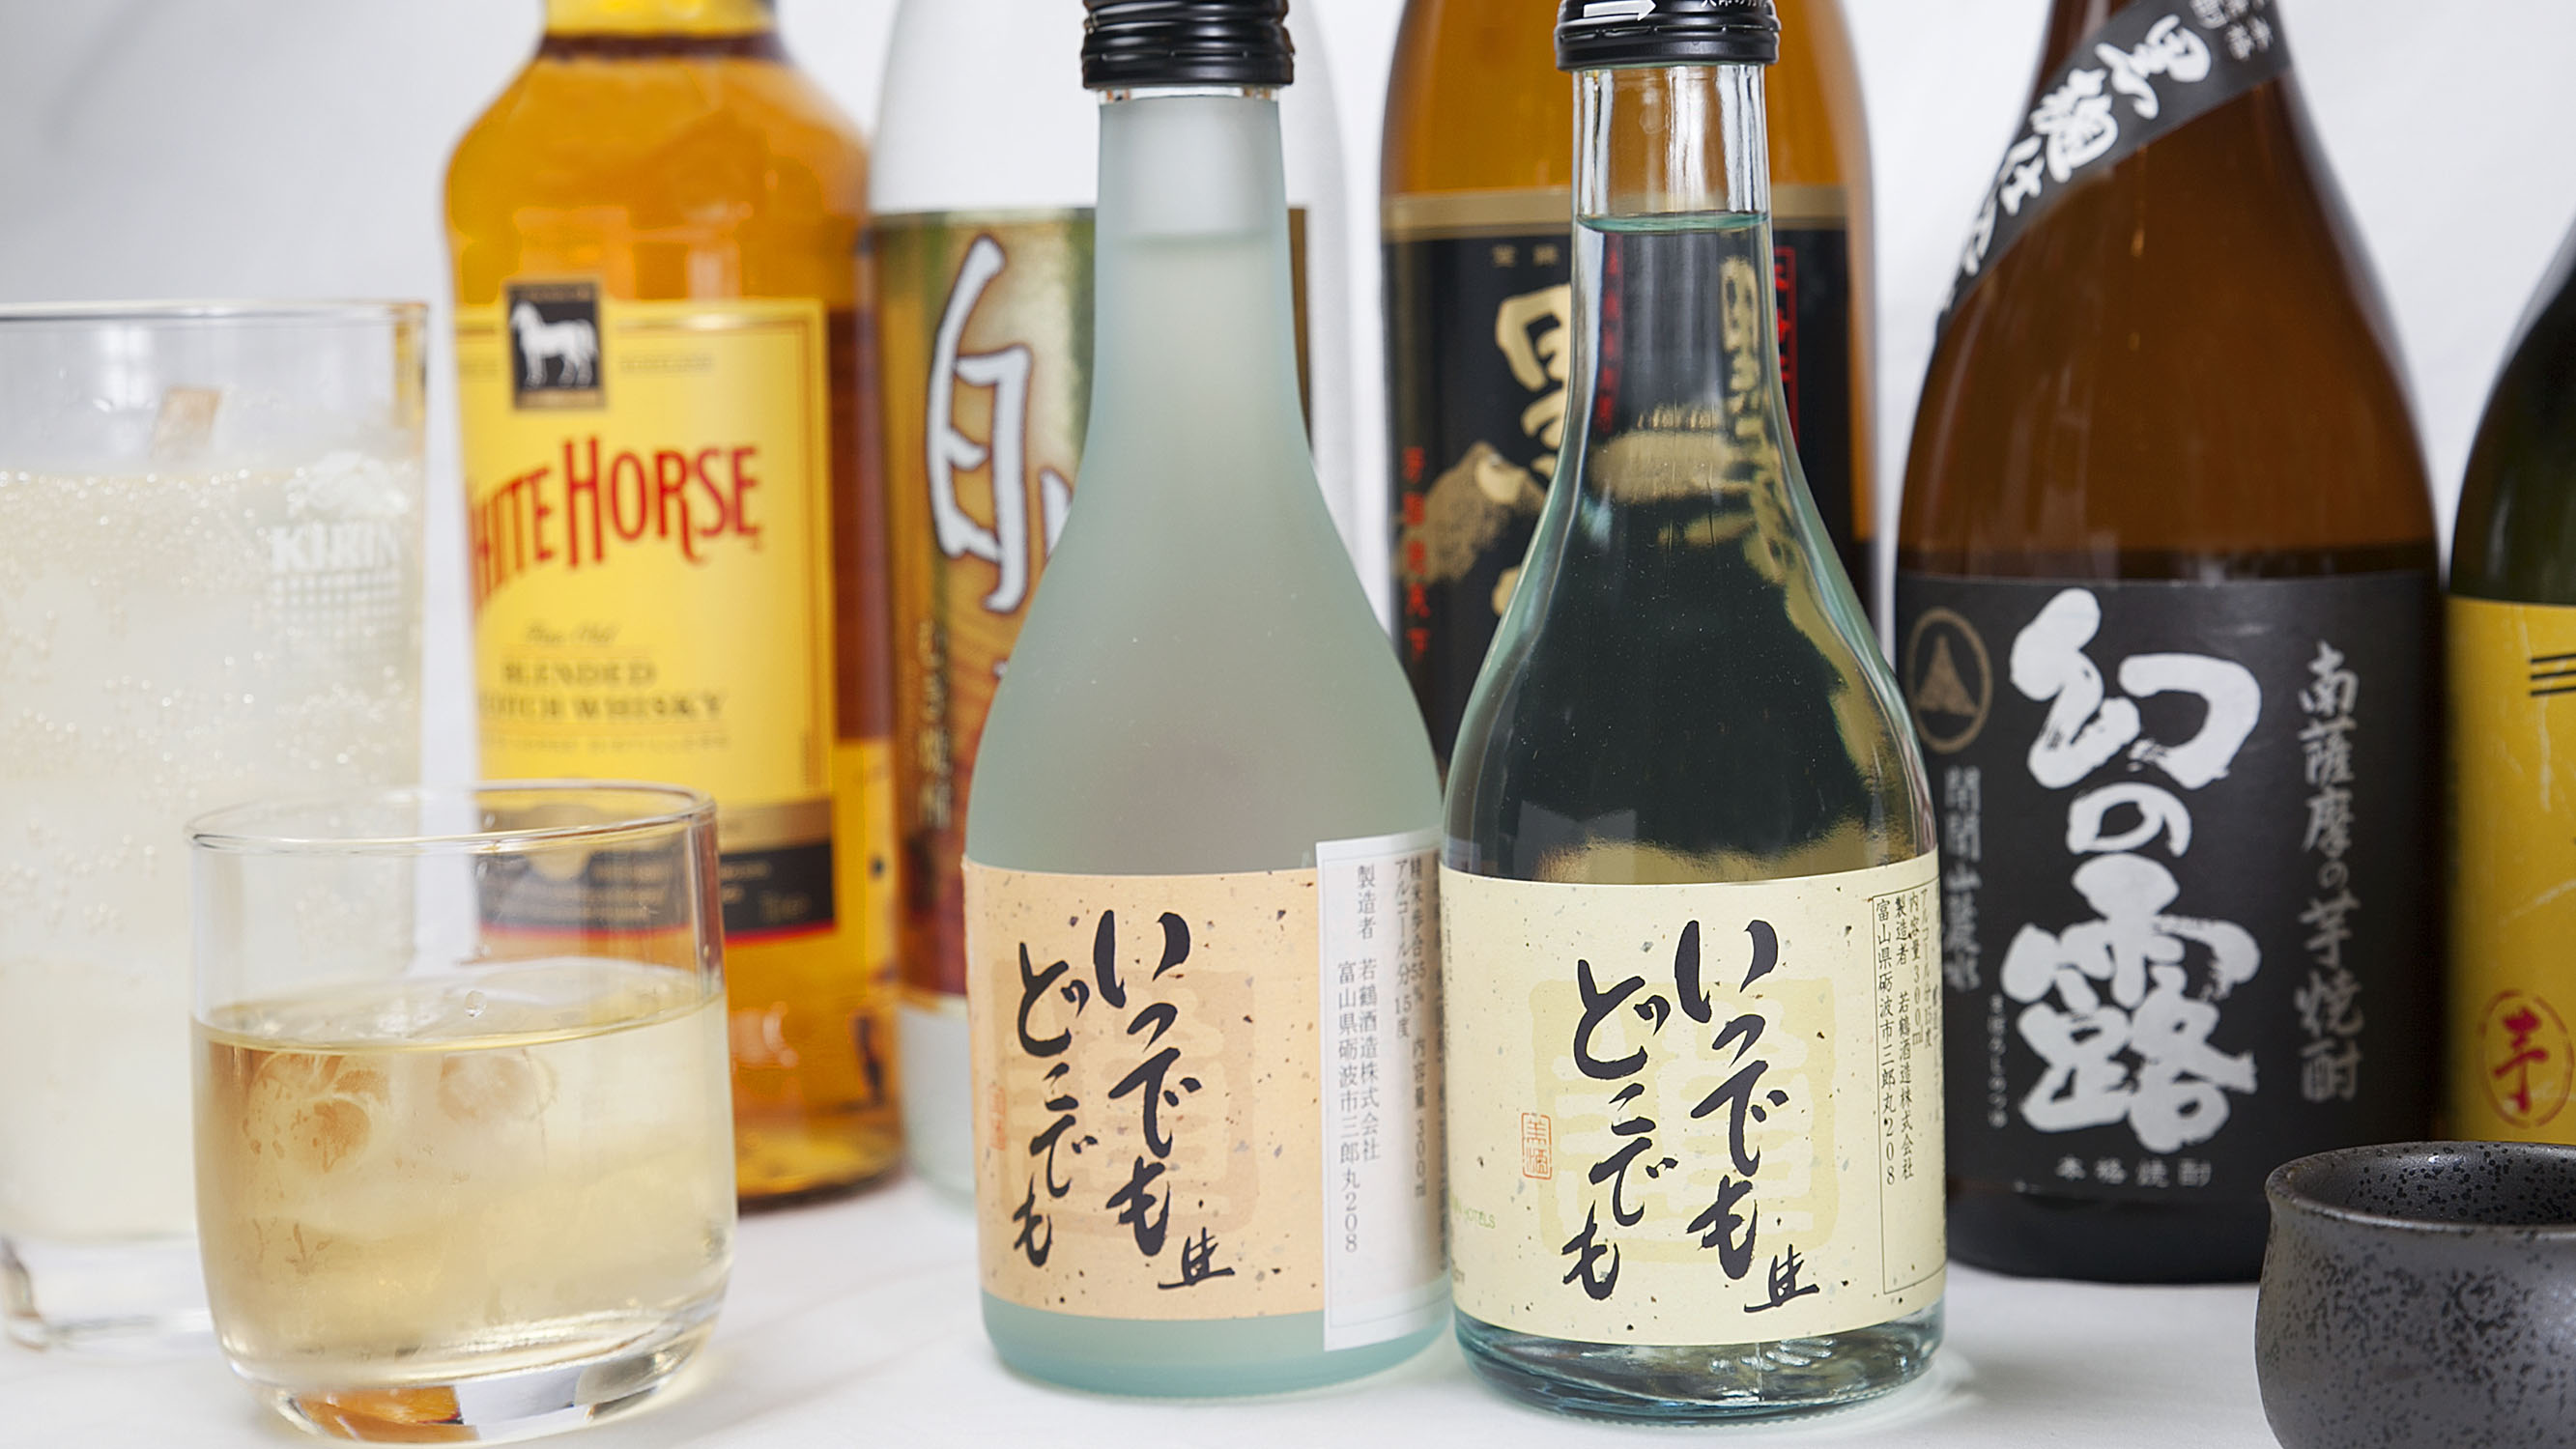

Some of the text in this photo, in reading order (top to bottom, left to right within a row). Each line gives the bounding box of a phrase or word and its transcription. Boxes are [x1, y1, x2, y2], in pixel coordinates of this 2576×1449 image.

[470, 435, 761, 618] HITE HORSE
[1357, 864, 1382, 1161] 製造者 若鶴酒造株式会社
[2001, 587, 2262, 1152] 幻の露
[2295, 639, 2360, 1101] 南薩摩の芋焼酎
[1013, 942, 1099, 1267] どこでも
[1093, 909, 1203, 1256] いつでも
[1337, 960, 1361, 1253] 富山県砺波市三郎丸208
[1560, 958, 1678, 1301] どこでも
[1674, 919, 1789, 1280] いつでも
[1875, 898, 1898, 1185] 富山県砺波市三郎丸208
[1894, 894, 1914, 1180] 製造者 若鶴酒造株式会社
[2493, 1006, 2551, 1115] 芋
